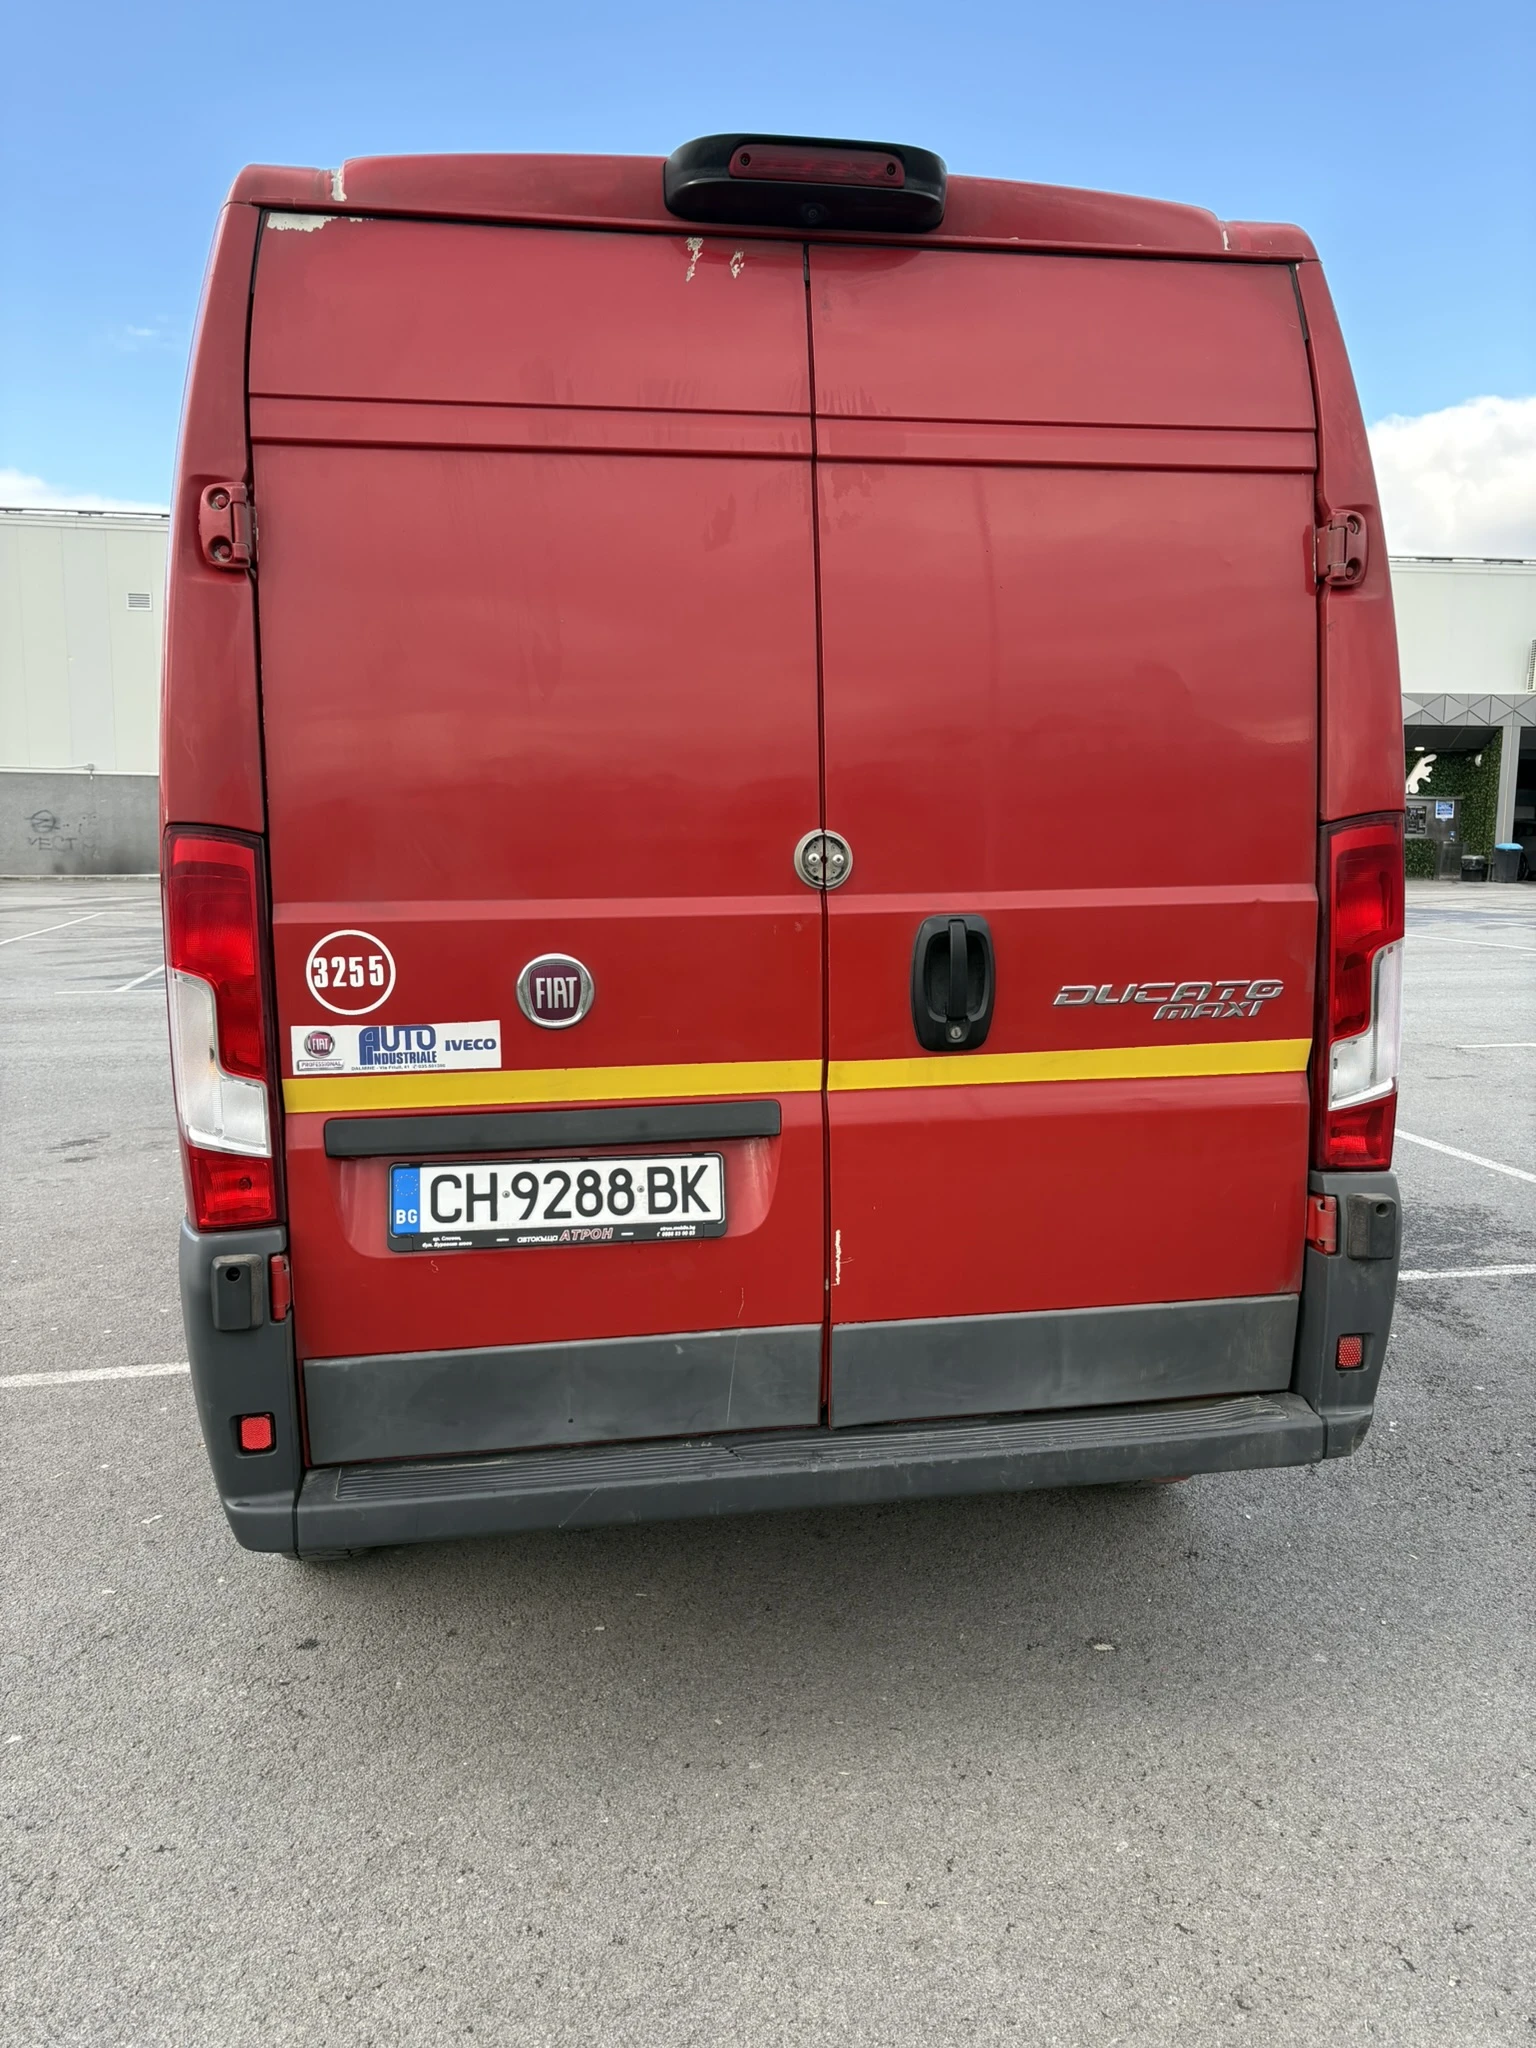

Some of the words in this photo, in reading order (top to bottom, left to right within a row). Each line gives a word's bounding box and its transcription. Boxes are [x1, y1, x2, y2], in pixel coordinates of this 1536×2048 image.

[312, 955, 384, 988] 3255
[535, 976, 580, 1010] FIAT
[1052, 979, 1284, 1006] DUCATO
[1152, 1000, 1263, 1020] MAXI
[312, 1037, 329, 1051] FIAT
[358, 1025, 437, 1062] AUTO
[444, 1037, 497, 1052] IVECO
[365, 1047, 437, 1065] INDUSTRIALE
[430, 1173, 498, 1223] CH
[511, 1168, 635, 1221] 9288
[646, 1164, 711, 1215] BK
[395, 1208, 418, 1225] BG
[559, 1227, 614, 1242] АТРОН
